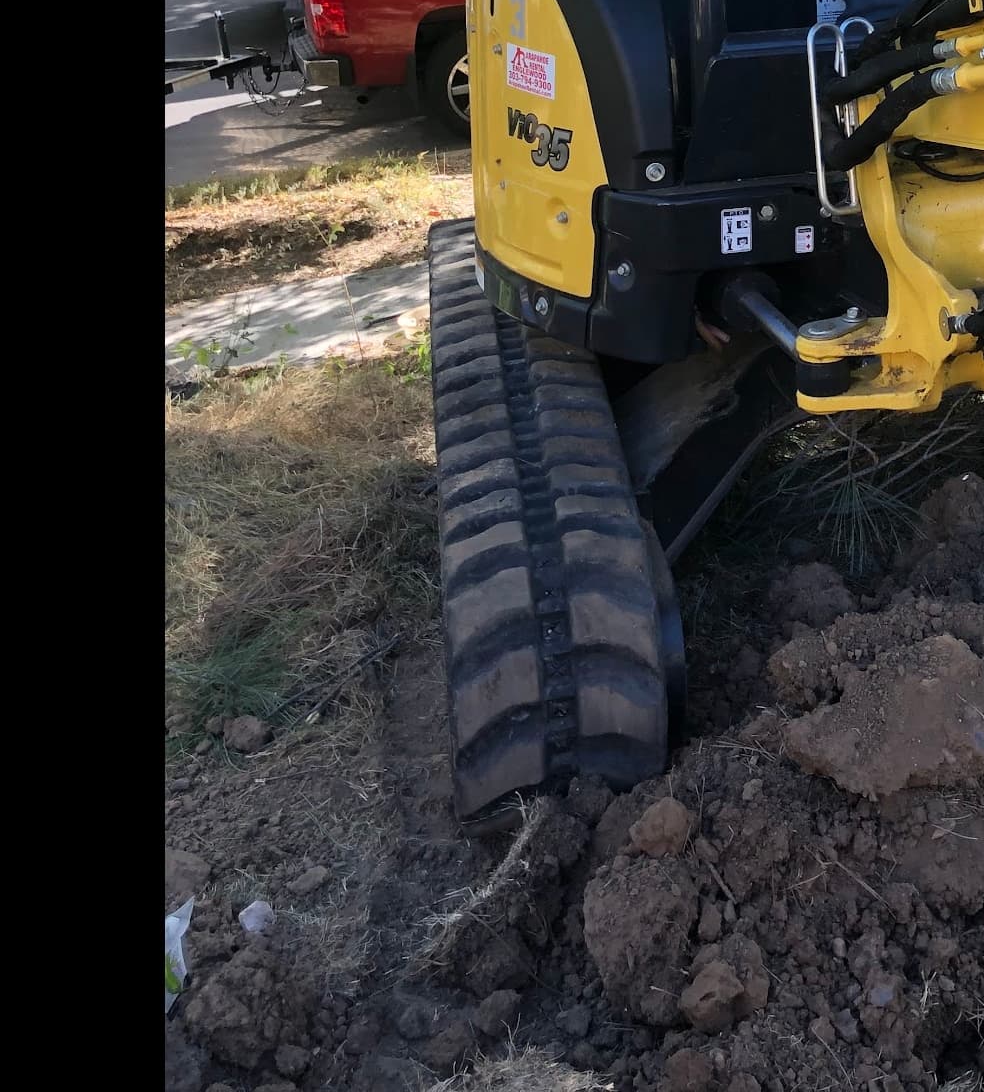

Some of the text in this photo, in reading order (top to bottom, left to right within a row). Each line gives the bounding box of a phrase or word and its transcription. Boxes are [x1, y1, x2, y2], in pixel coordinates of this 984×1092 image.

[525, 51, 549, 65] ARAPAHOE
[512, 64, 547, 81] ENGLEWOOD
[529, 61, 546, 73] RENTAL
[508, 70, 552, 91] 303-794-9300
